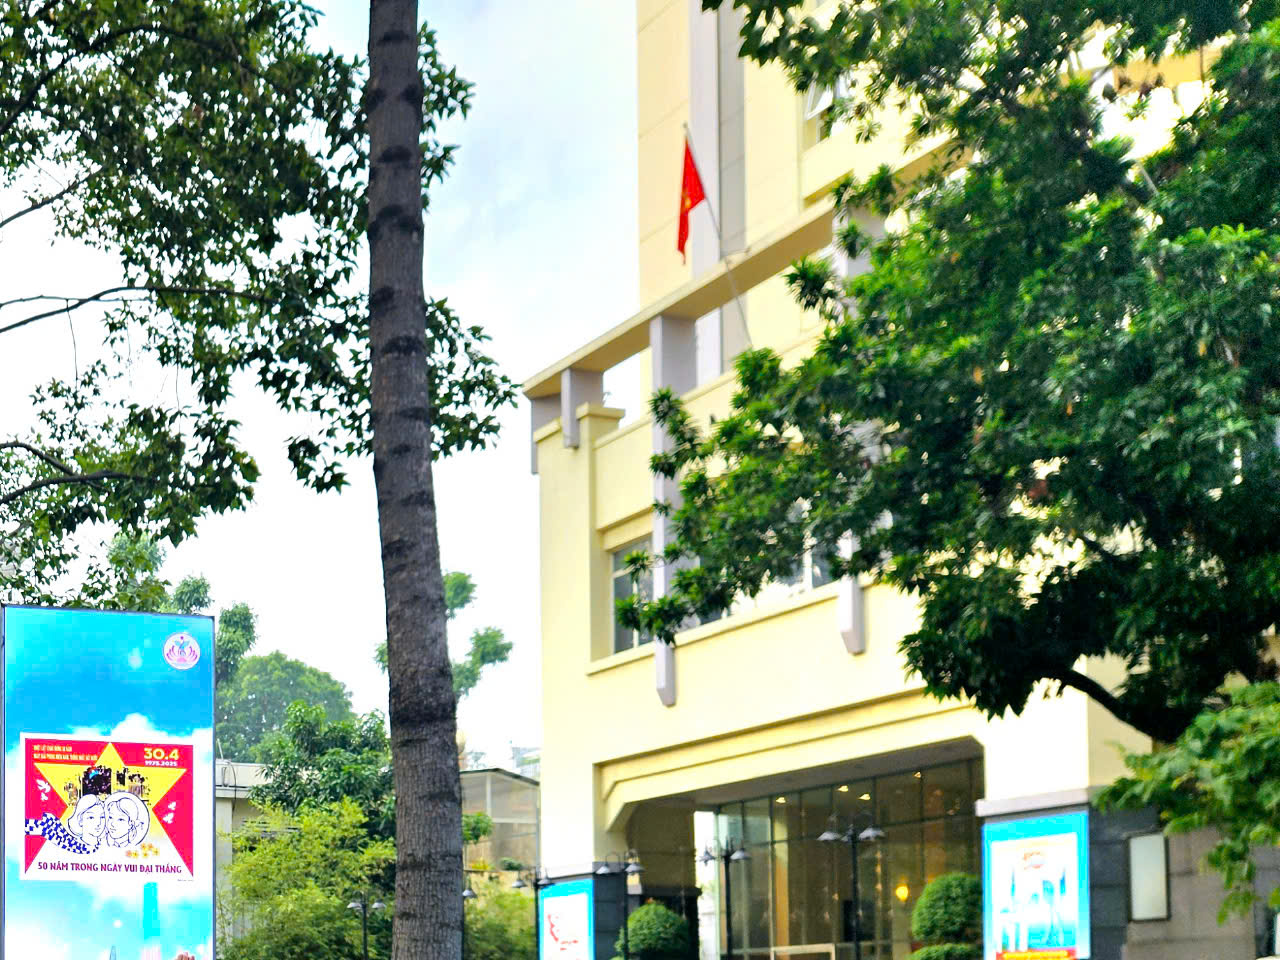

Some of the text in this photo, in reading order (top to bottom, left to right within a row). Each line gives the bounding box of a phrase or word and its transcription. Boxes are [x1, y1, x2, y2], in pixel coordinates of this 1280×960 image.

[143, 747, 179, 761] 30.4
[37, 861, 48, 870] 50
[50, 860, 68, 871] NĂM
[70, 862, 98, 872] TRONG
[124, 864, 138, 873] VUI
